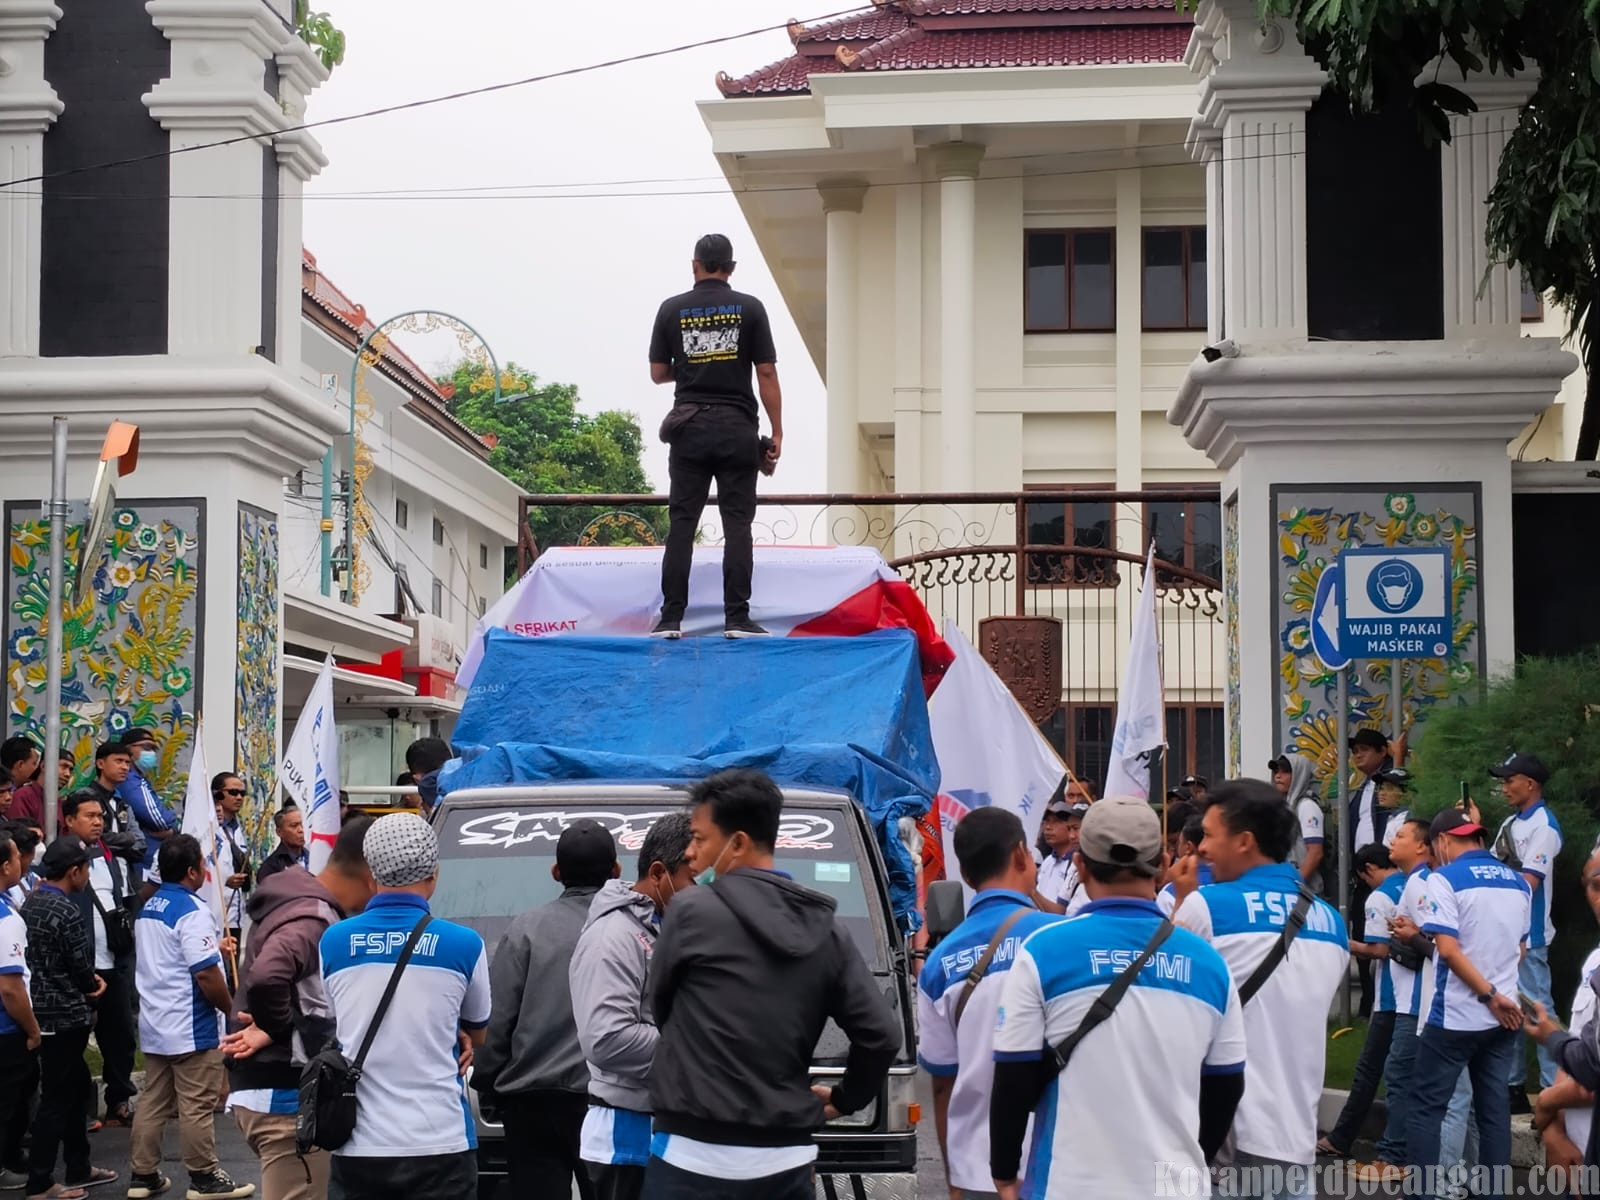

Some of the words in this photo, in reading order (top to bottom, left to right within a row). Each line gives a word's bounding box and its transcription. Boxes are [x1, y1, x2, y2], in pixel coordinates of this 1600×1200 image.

[680, 304, 742, 317] FSPMI
[514, 620, 577, 634] SERIKAT
[1349, 623, 1393, 636] WAJIB
[1399, 623, 1441, 635] PAKAI
[1367, 639, 1424, 652] MASKER
[283, 759, 304, 791] PUK
[1243, 891, 1337, 935] FSPMI
[941, 936, 1021, 979] FSPMI
[1089, 949, 1192, 984] FSPMI
